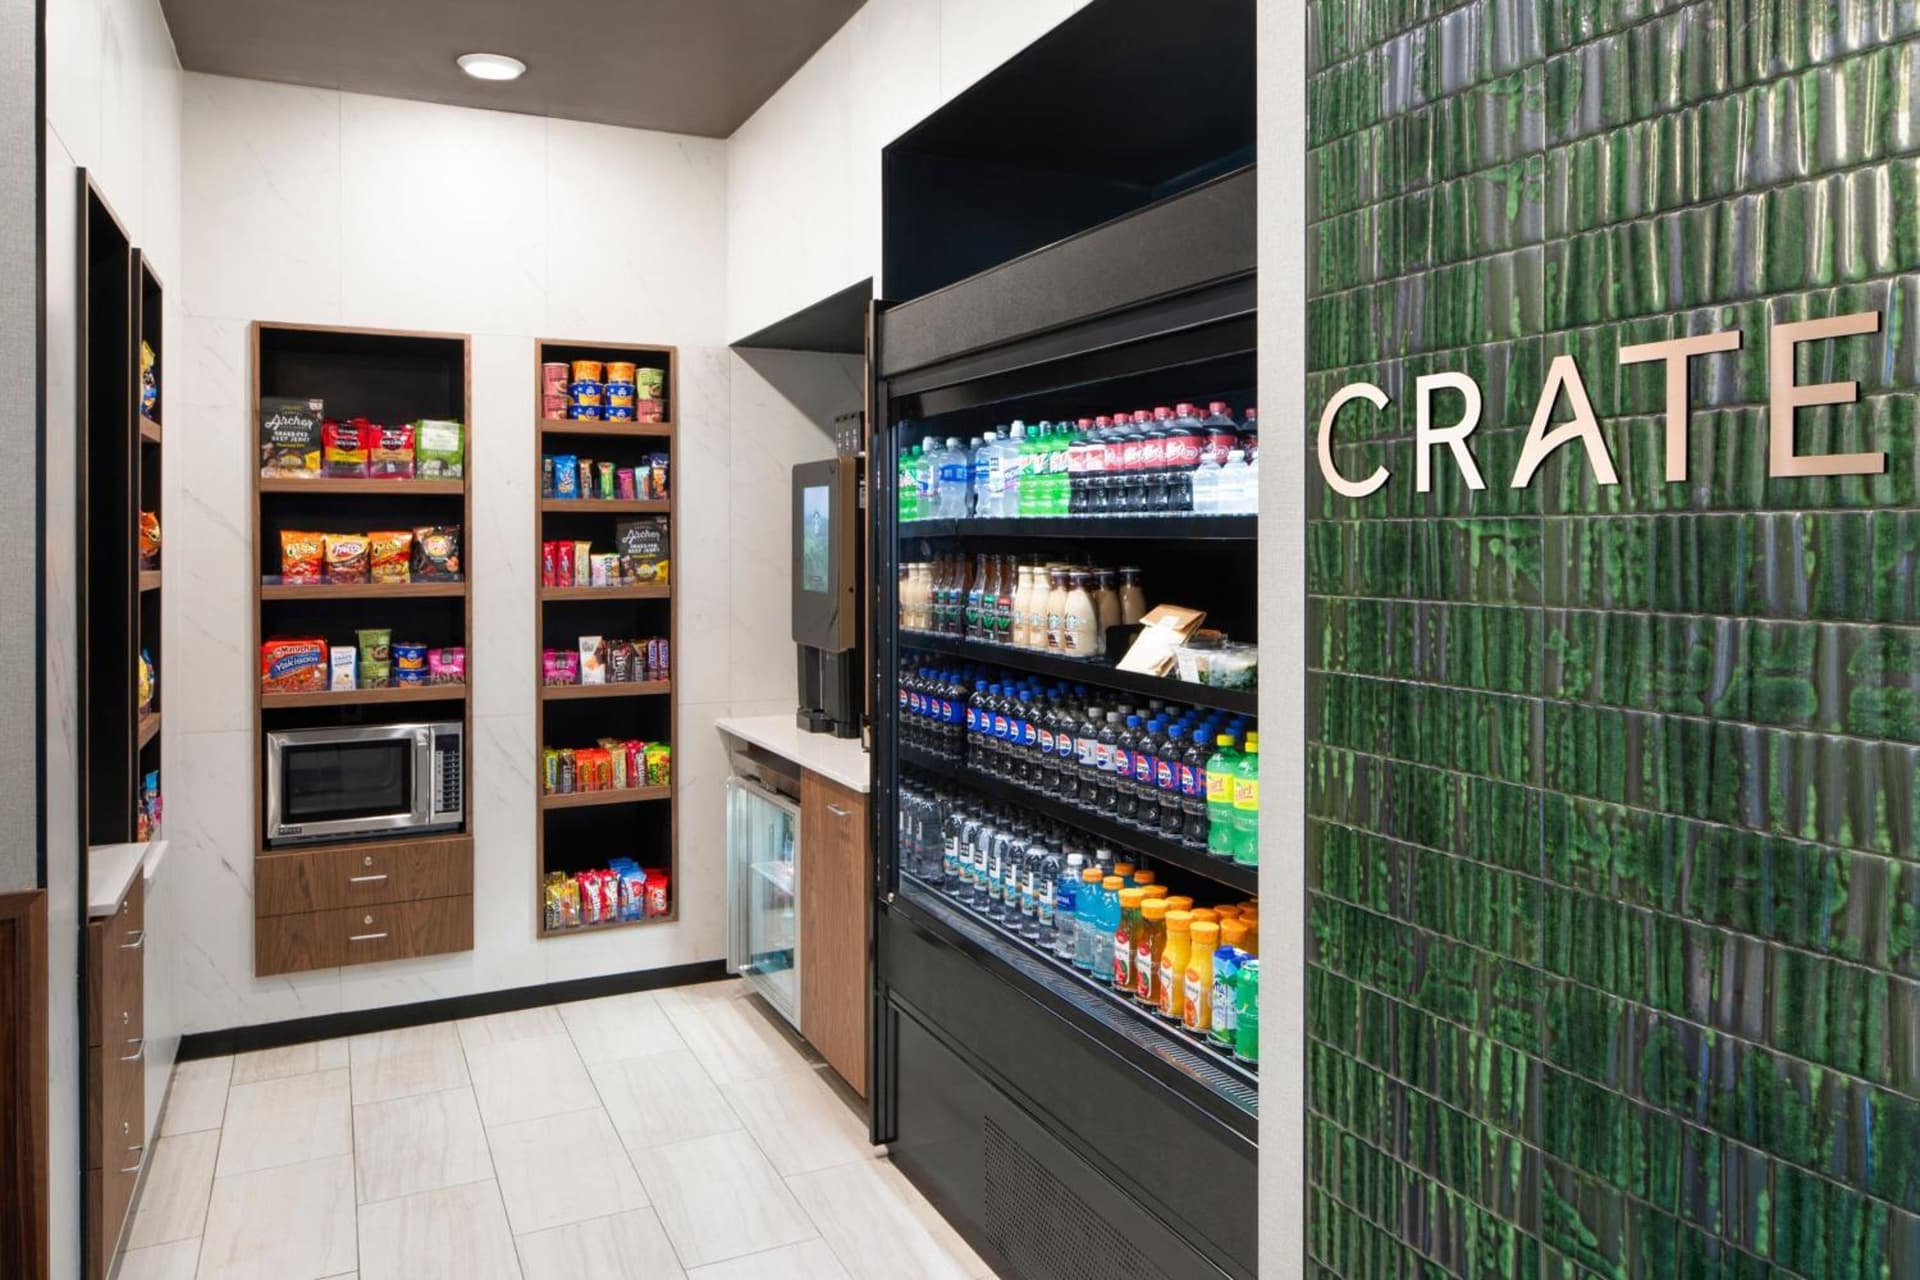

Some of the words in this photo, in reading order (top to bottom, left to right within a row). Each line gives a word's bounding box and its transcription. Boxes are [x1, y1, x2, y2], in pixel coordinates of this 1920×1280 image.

[1317, 310, 1886, 498] CRATE
[264, 413, 313, 431] Archer
[621, 528, 661, 545] Archer
[281, 645, 320, 654] Maruchan
